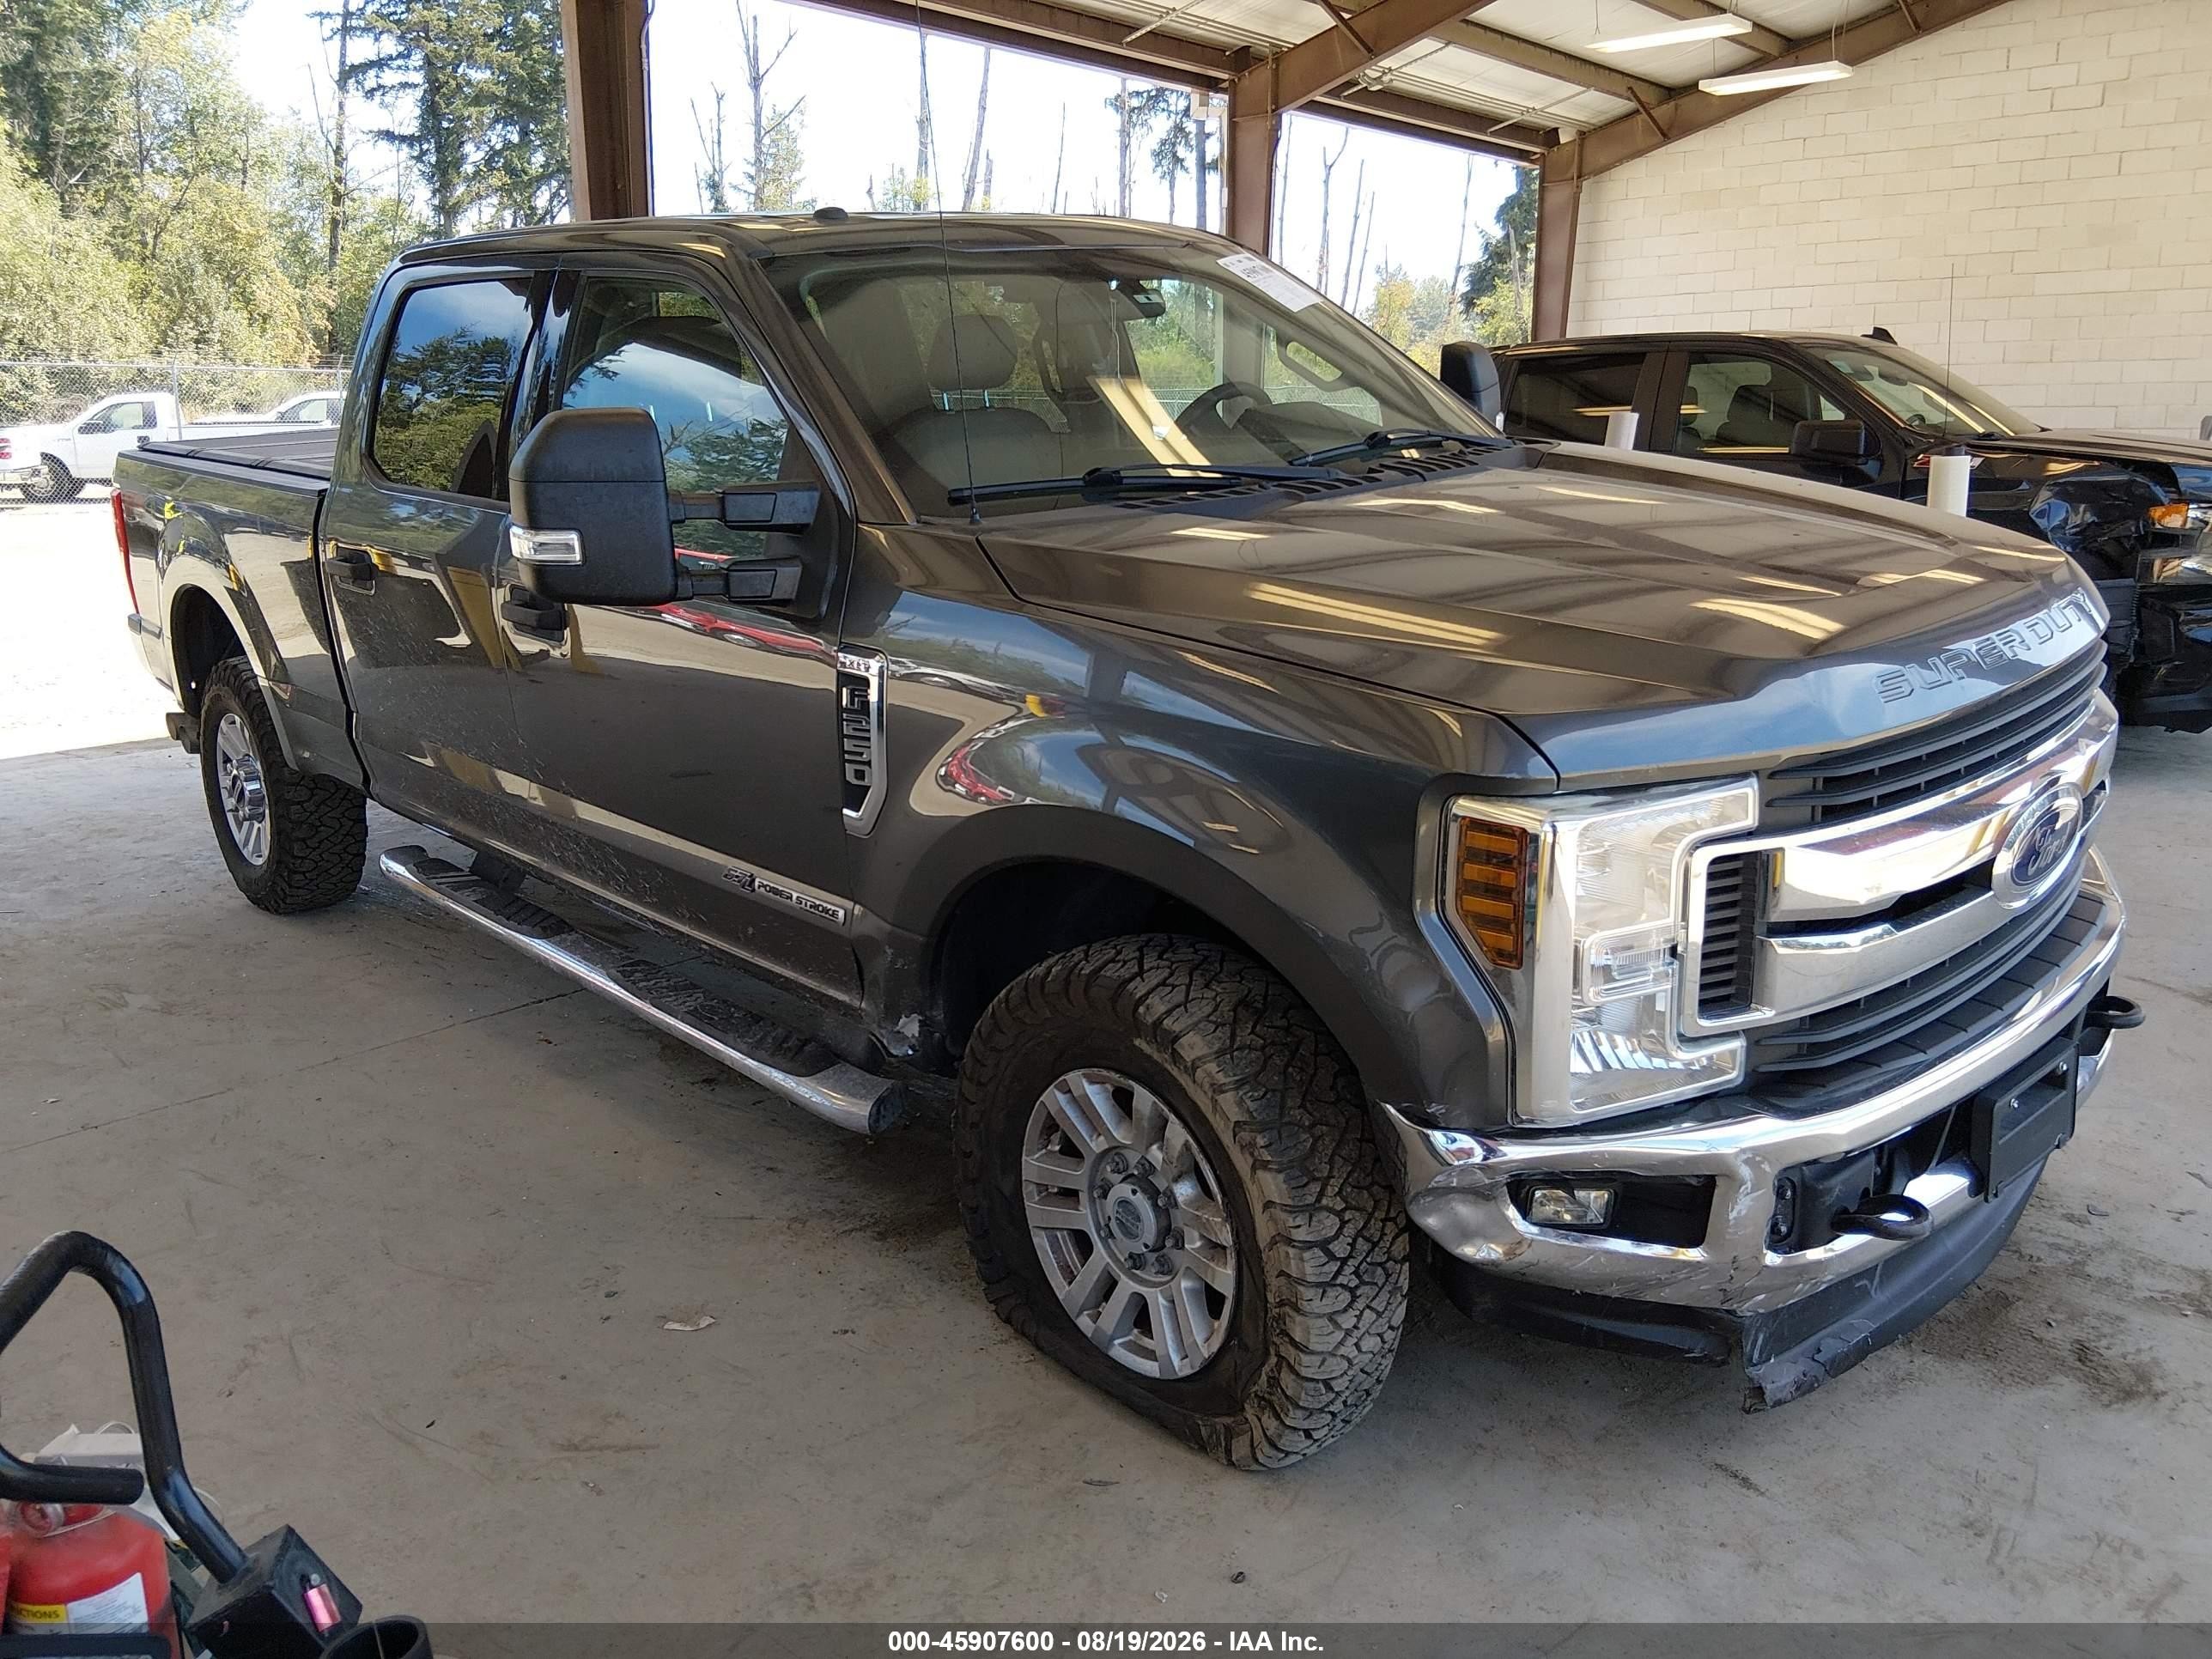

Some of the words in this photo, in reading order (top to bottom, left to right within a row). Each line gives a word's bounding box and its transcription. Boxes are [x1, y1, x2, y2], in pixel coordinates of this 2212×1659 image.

[1874, 628, 2033, 703] SUPER
[2024, 586, 2093, 645] DUTY
[757, 880, 793, 902] POWER
[795, 896, 840, 921] STROKE
